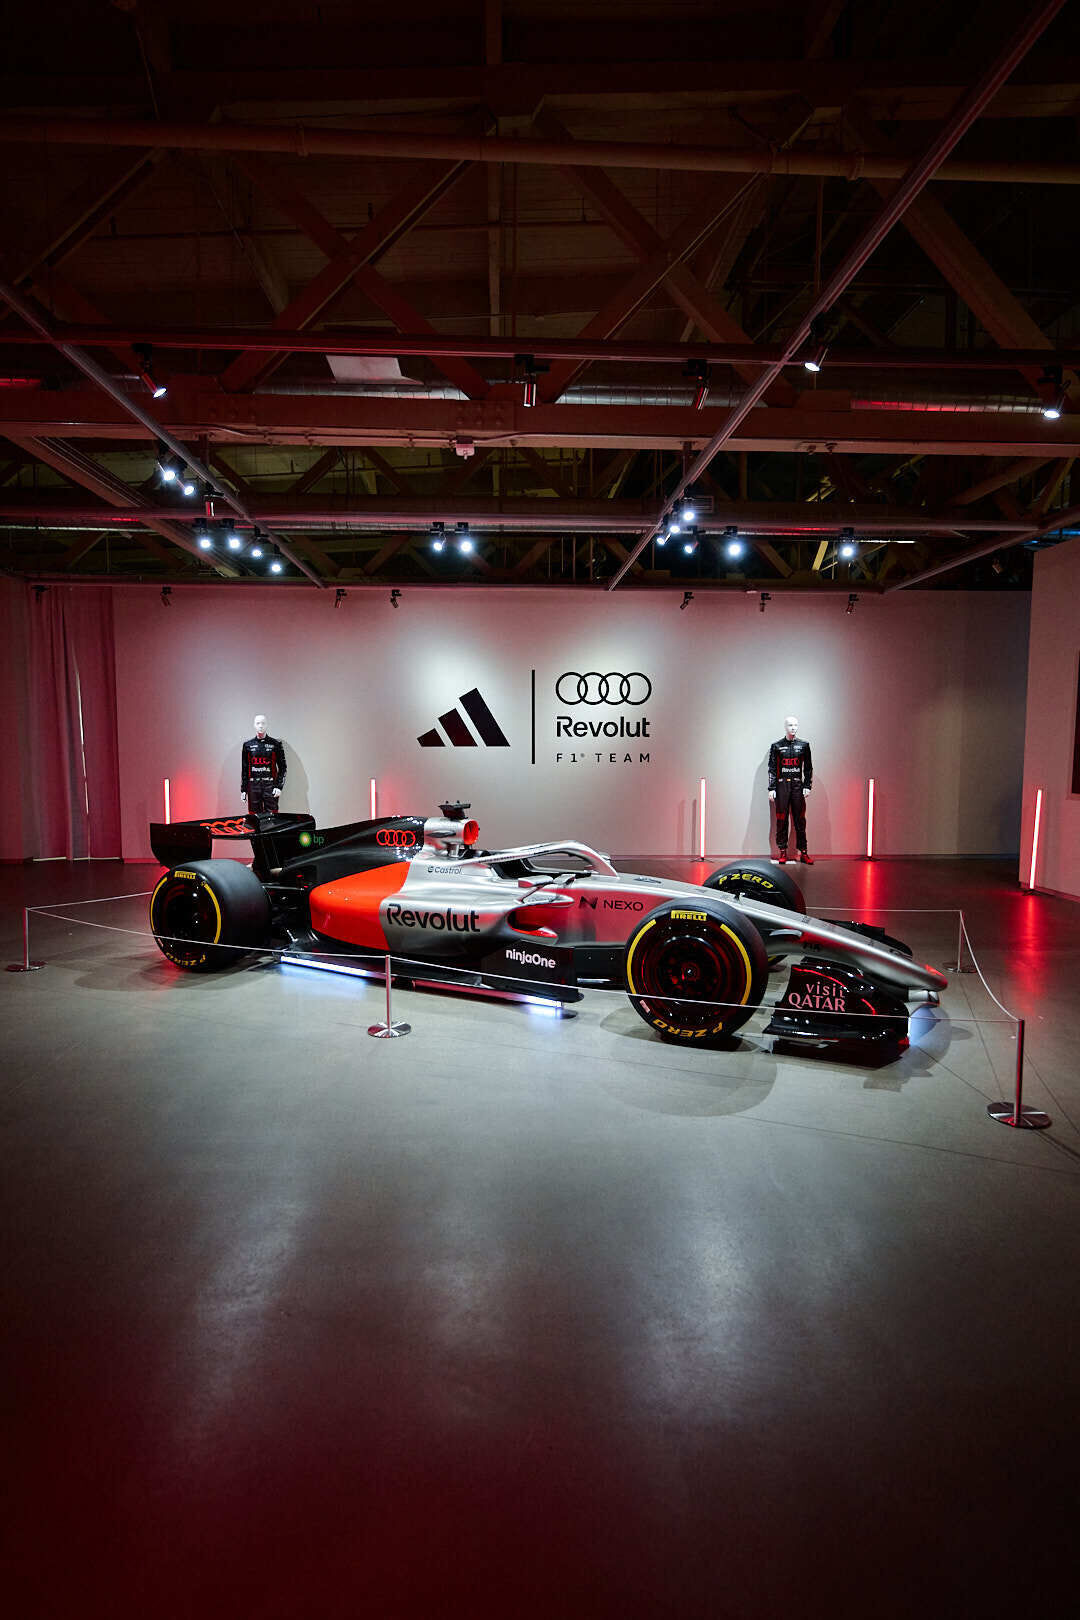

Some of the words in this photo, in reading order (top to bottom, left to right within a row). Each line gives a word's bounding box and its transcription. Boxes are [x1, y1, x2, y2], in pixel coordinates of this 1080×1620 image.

[556, 716, 650, 738] Revolut
[595, 753, 650, 763] TEAM
[313, 834, 325, 846] bp
[434, 866, 462, 875] Castrol
[730, 874, 774, 889] ZERO
[603, 900, 644, 911] NEXO
[386, 903, 481, 932] Revolut
[671, 909, 708, 921] PIRELLI
[505, 948, 556, 968] ninjaOne
[788, 992, 846, 1012] QATAR
[653, 1019, 708, 1038] ZERO
